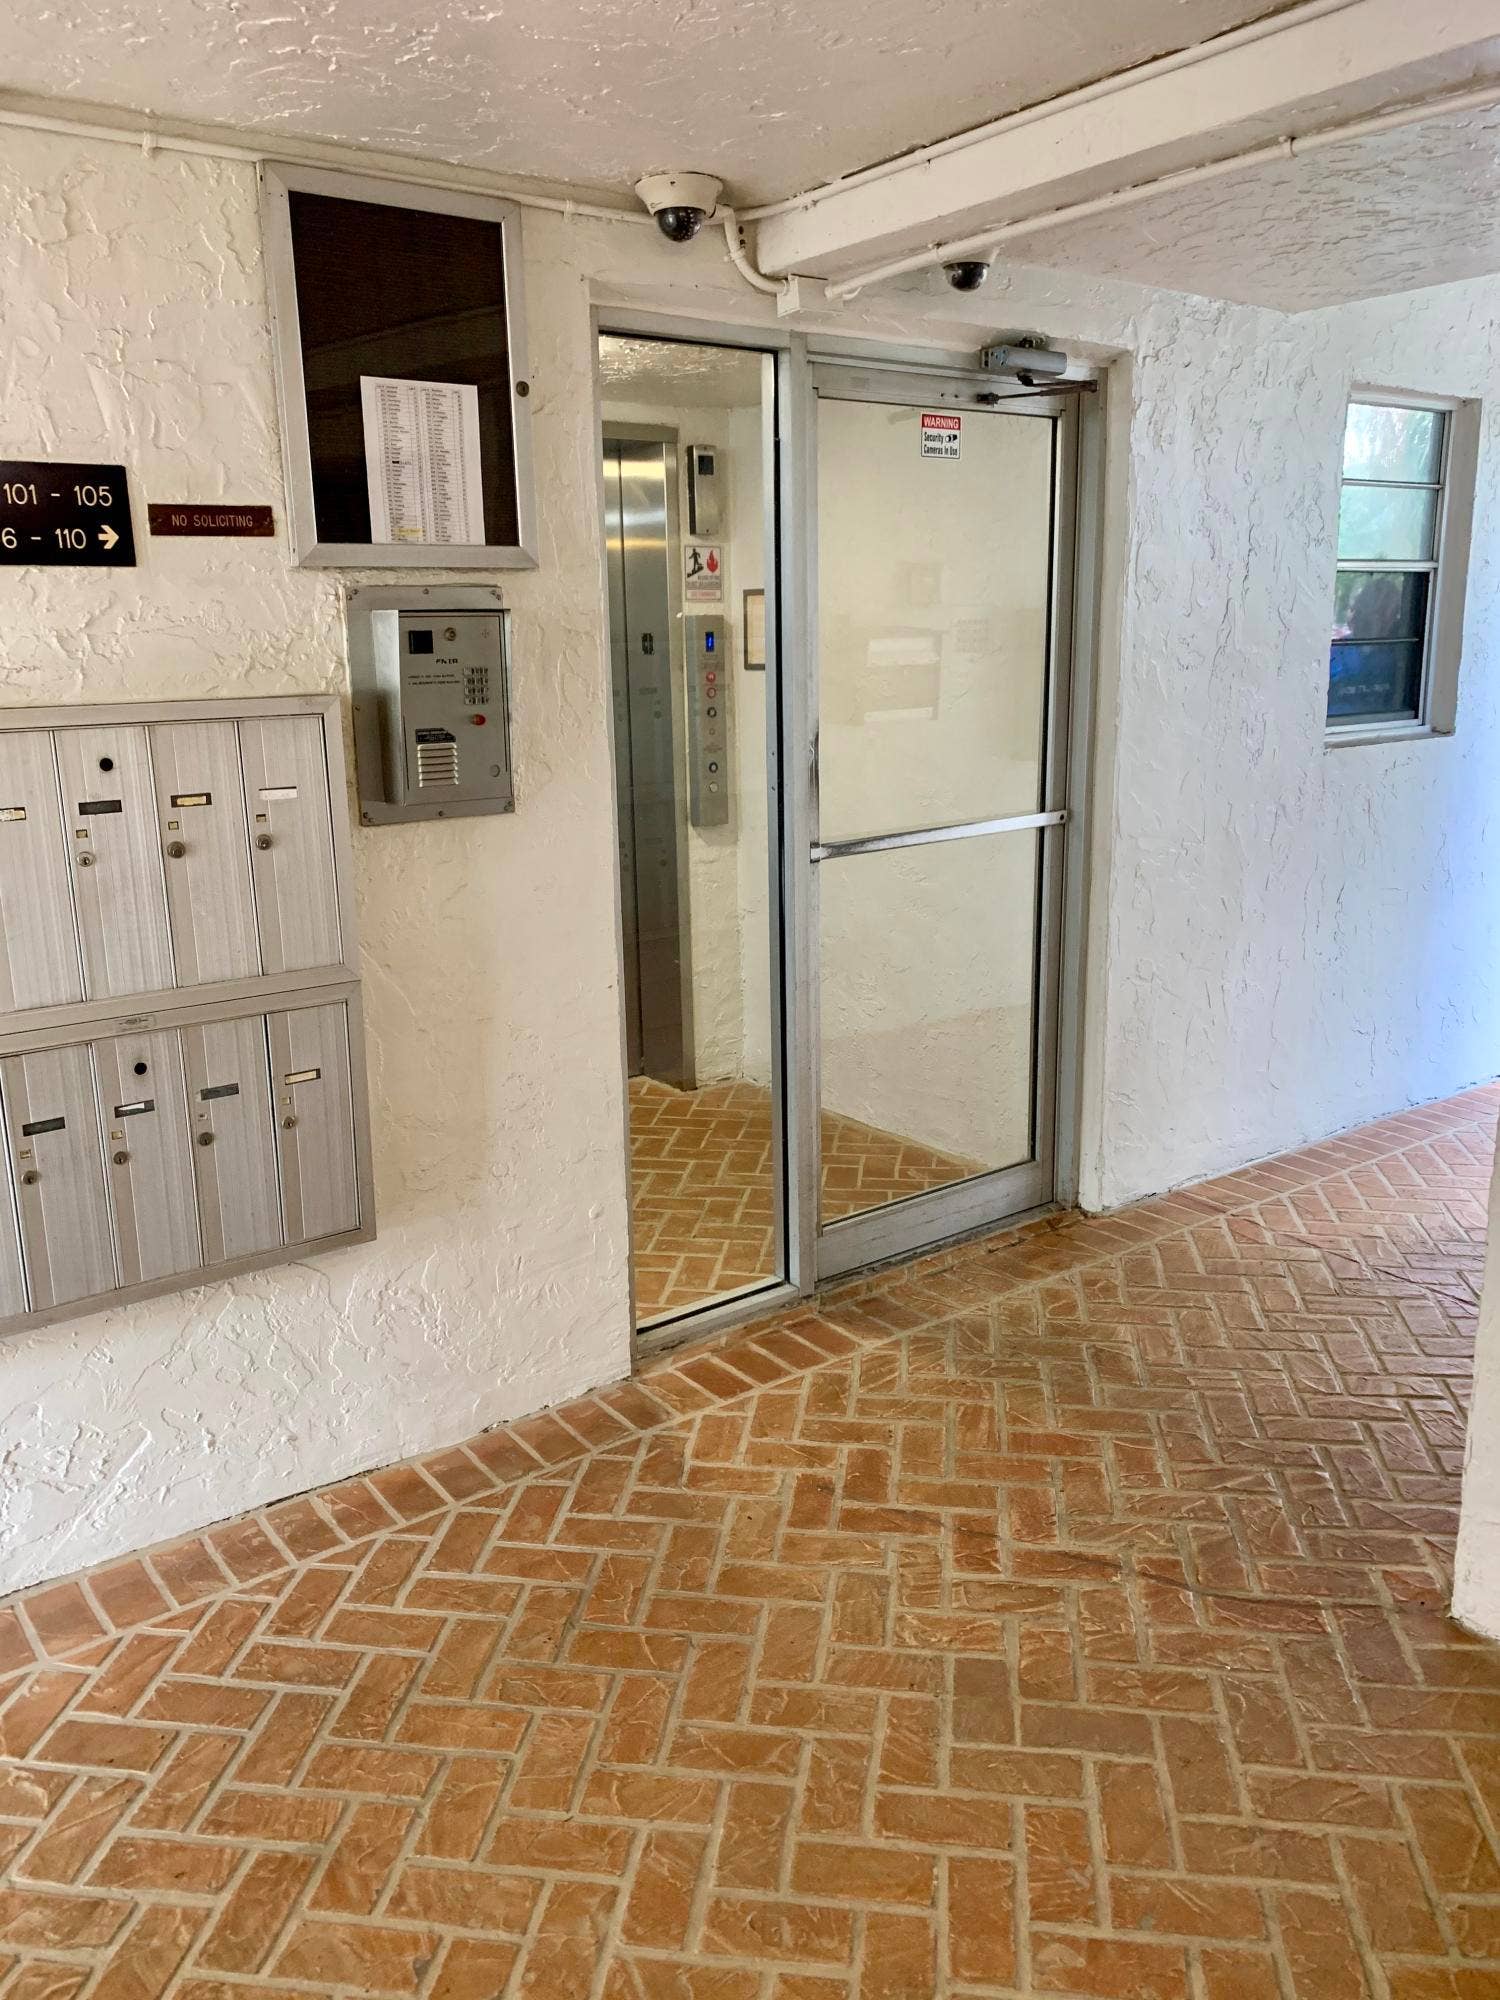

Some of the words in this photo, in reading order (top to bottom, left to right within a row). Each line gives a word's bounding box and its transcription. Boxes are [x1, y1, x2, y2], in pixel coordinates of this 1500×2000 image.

[923, 415, 959, 429] WARNING
[924, 431, 944, 445] Security
[924, 444, 943, 455] Cameras
[3, 483, 37, 505] 101
[73, 485, 113, 507] 105
[171, 514, 188, 527] NO
[193, 514, 253, 527] SOLICITING
[1, 527, 18, 549] 6
[54, 528, 87, 549] 110
